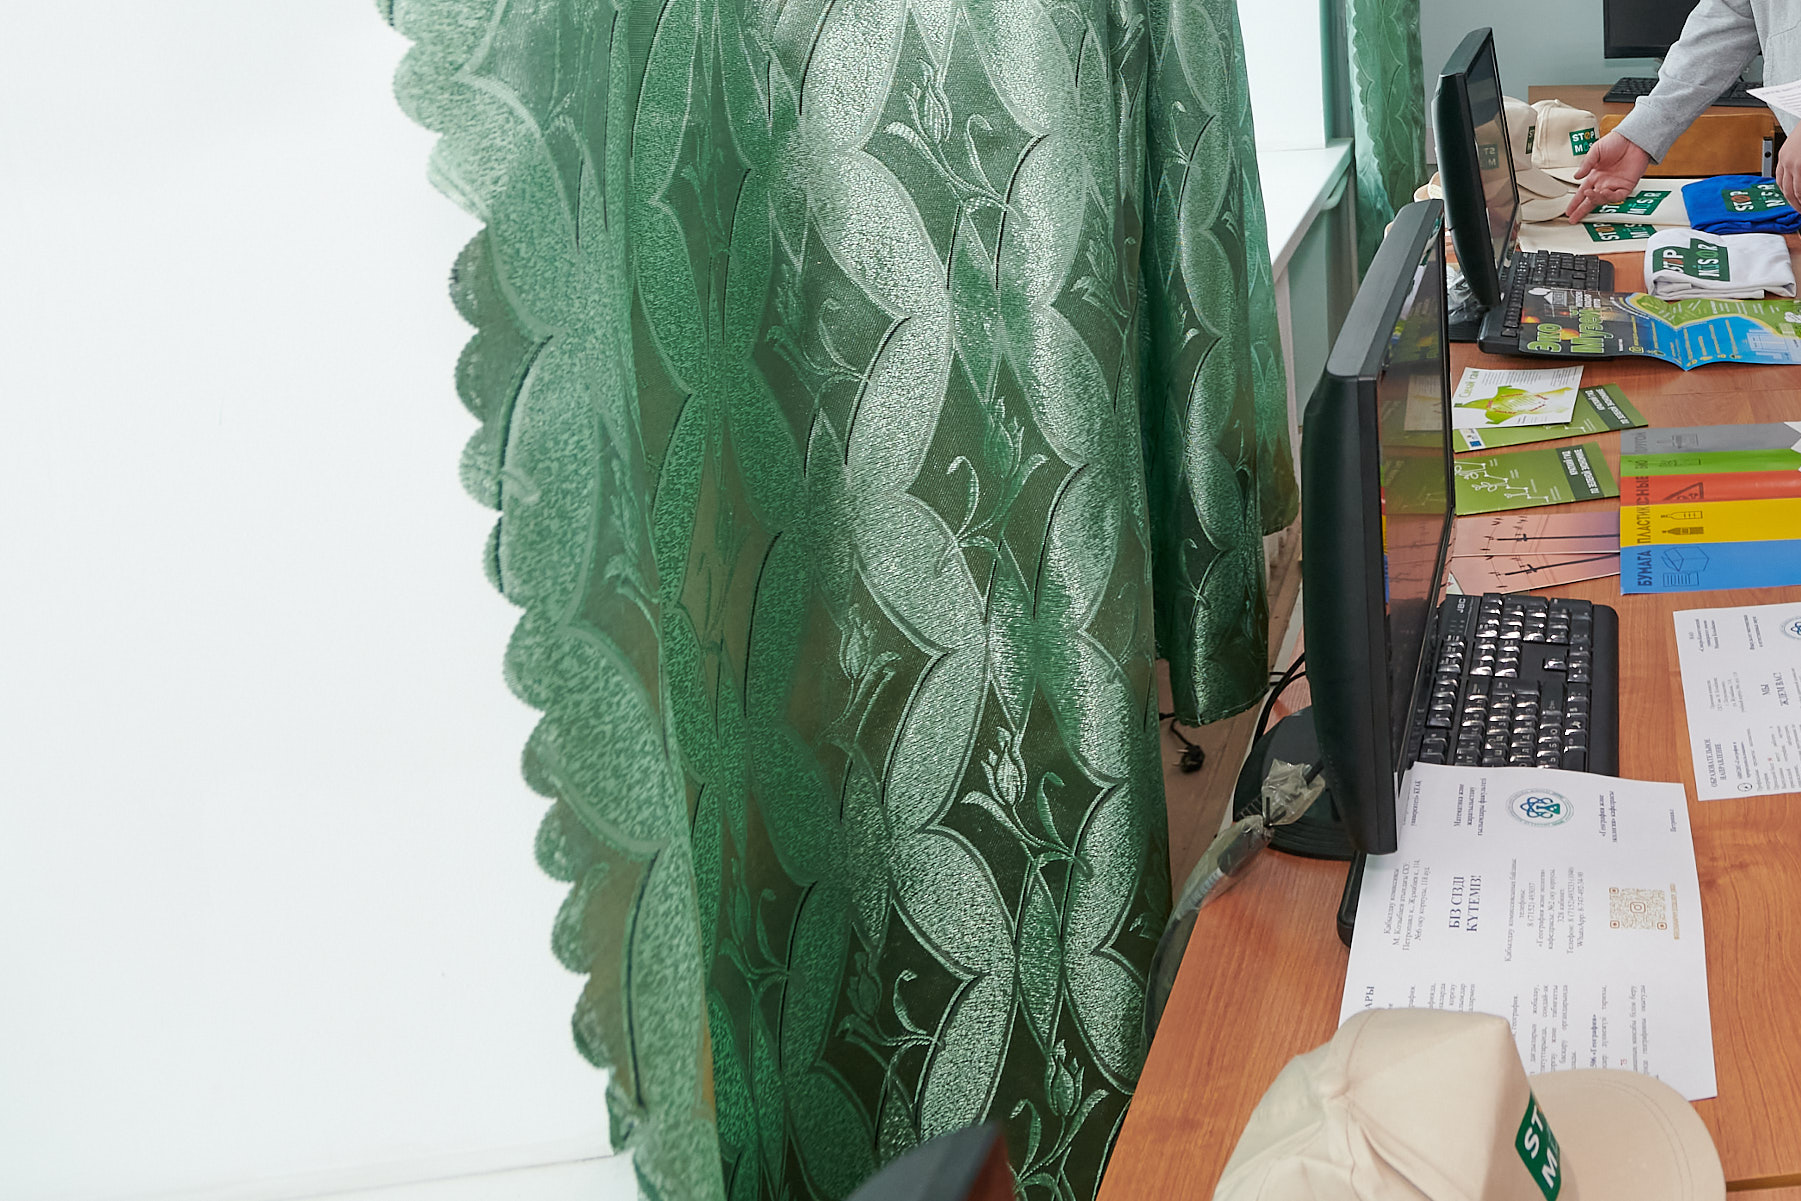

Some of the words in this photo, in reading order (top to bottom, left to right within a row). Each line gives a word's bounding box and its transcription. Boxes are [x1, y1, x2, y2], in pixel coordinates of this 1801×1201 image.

[1572, 131, 1595, 142] STOP
[1730, 191, 1754, 211] STOP
[1527, 323, 1562, 353] Эко
[1569, 308, 1613, 353] Музей
[1637, 551, 1653, 586] БУМАГА
[1450, 876, 1464, 906] СІЗДІ
[1466, 875, 1481, 932] КҮТЕМІЗ!
[1449, 908, 1462, 928] БІЗ
